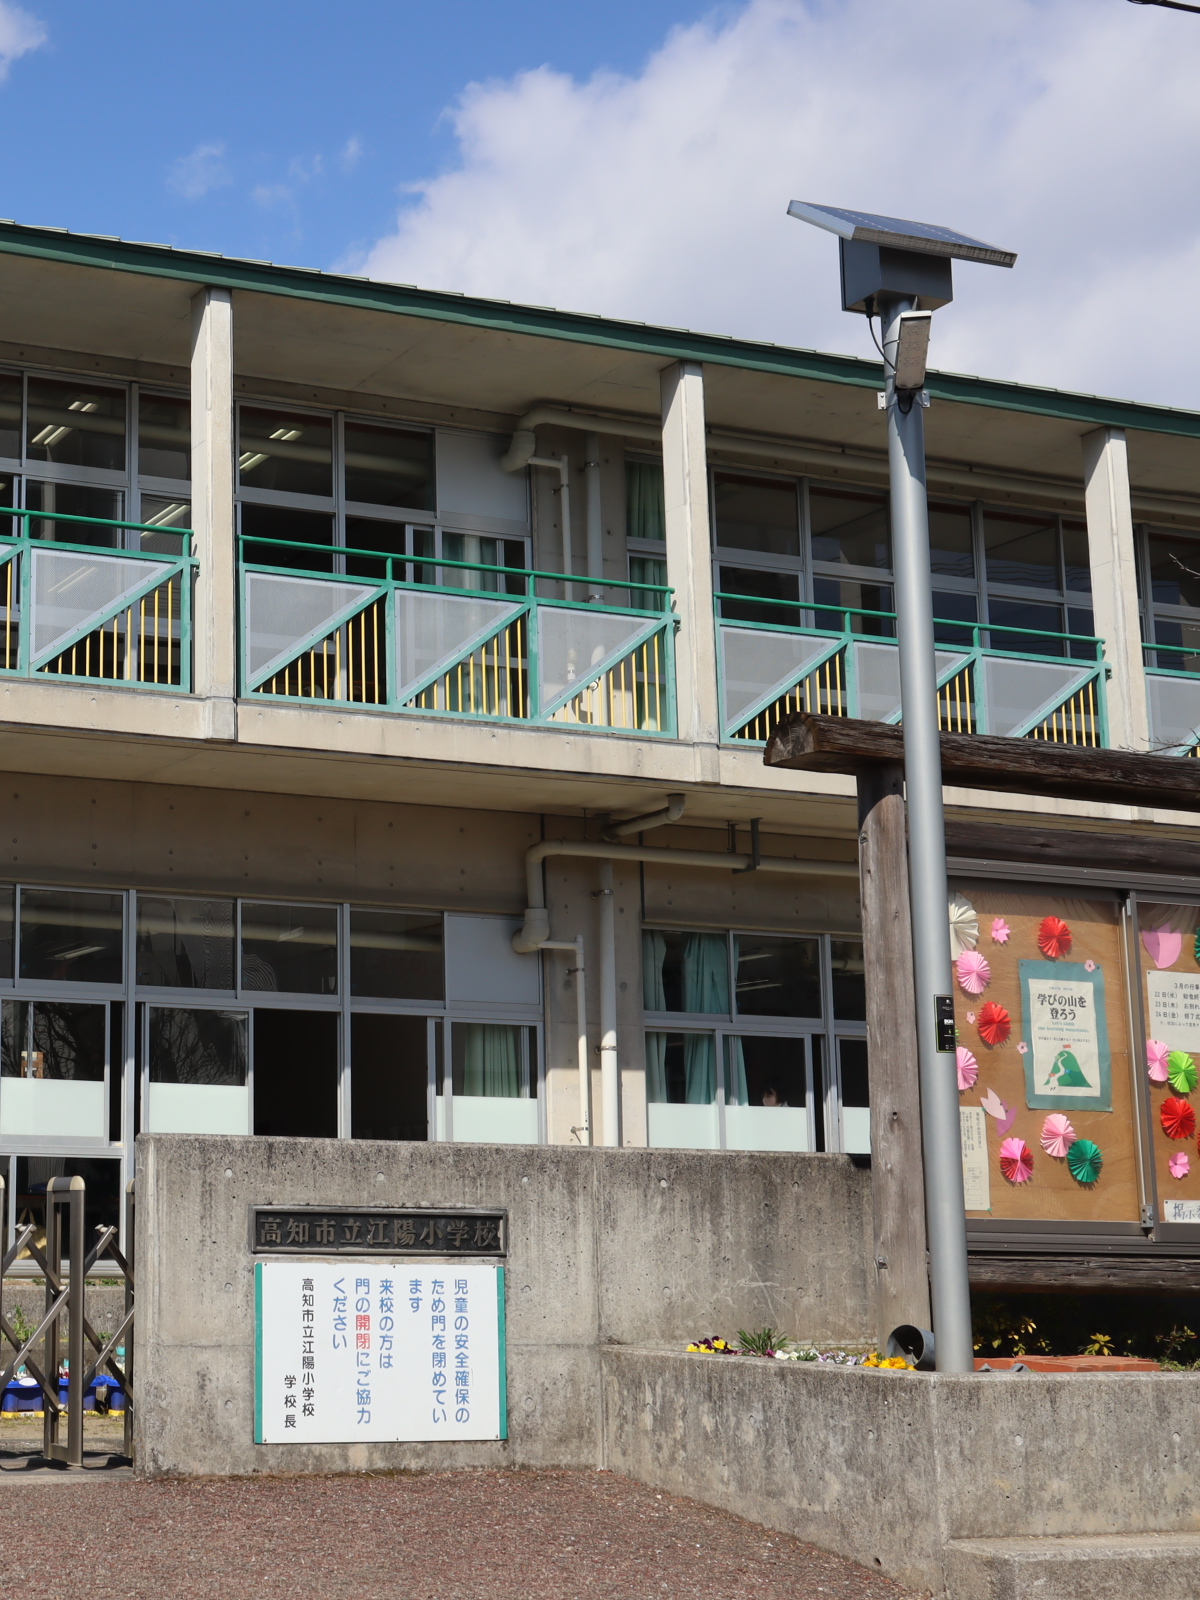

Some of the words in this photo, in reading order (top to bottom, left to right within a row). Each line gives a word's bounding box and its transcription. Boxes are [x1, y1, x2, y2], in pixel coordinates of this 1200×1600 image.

[1037, 993, 1087, 1008] 学びの山を
[1050, 1007, 1076, 1021] 登ろう
[259, 1217, 499, 1247] 高知市立江陽小学校
[332, 1277, 347, 1349] ください
[379, 1279, 394, 1369] 来校の方は
[408, 1279, 423, 1313] ます
[301, 1278, 315, 1417] 高知市立江陽小学校
[355, 1278, 371, 1425] 門の開閉にご協力
[431, 1279, 447, 1424] ため門を閉めてい
[453, 1278, 470, 1424] 児童の安全確保の
[284, 1375, 297, 1429] 学校長
